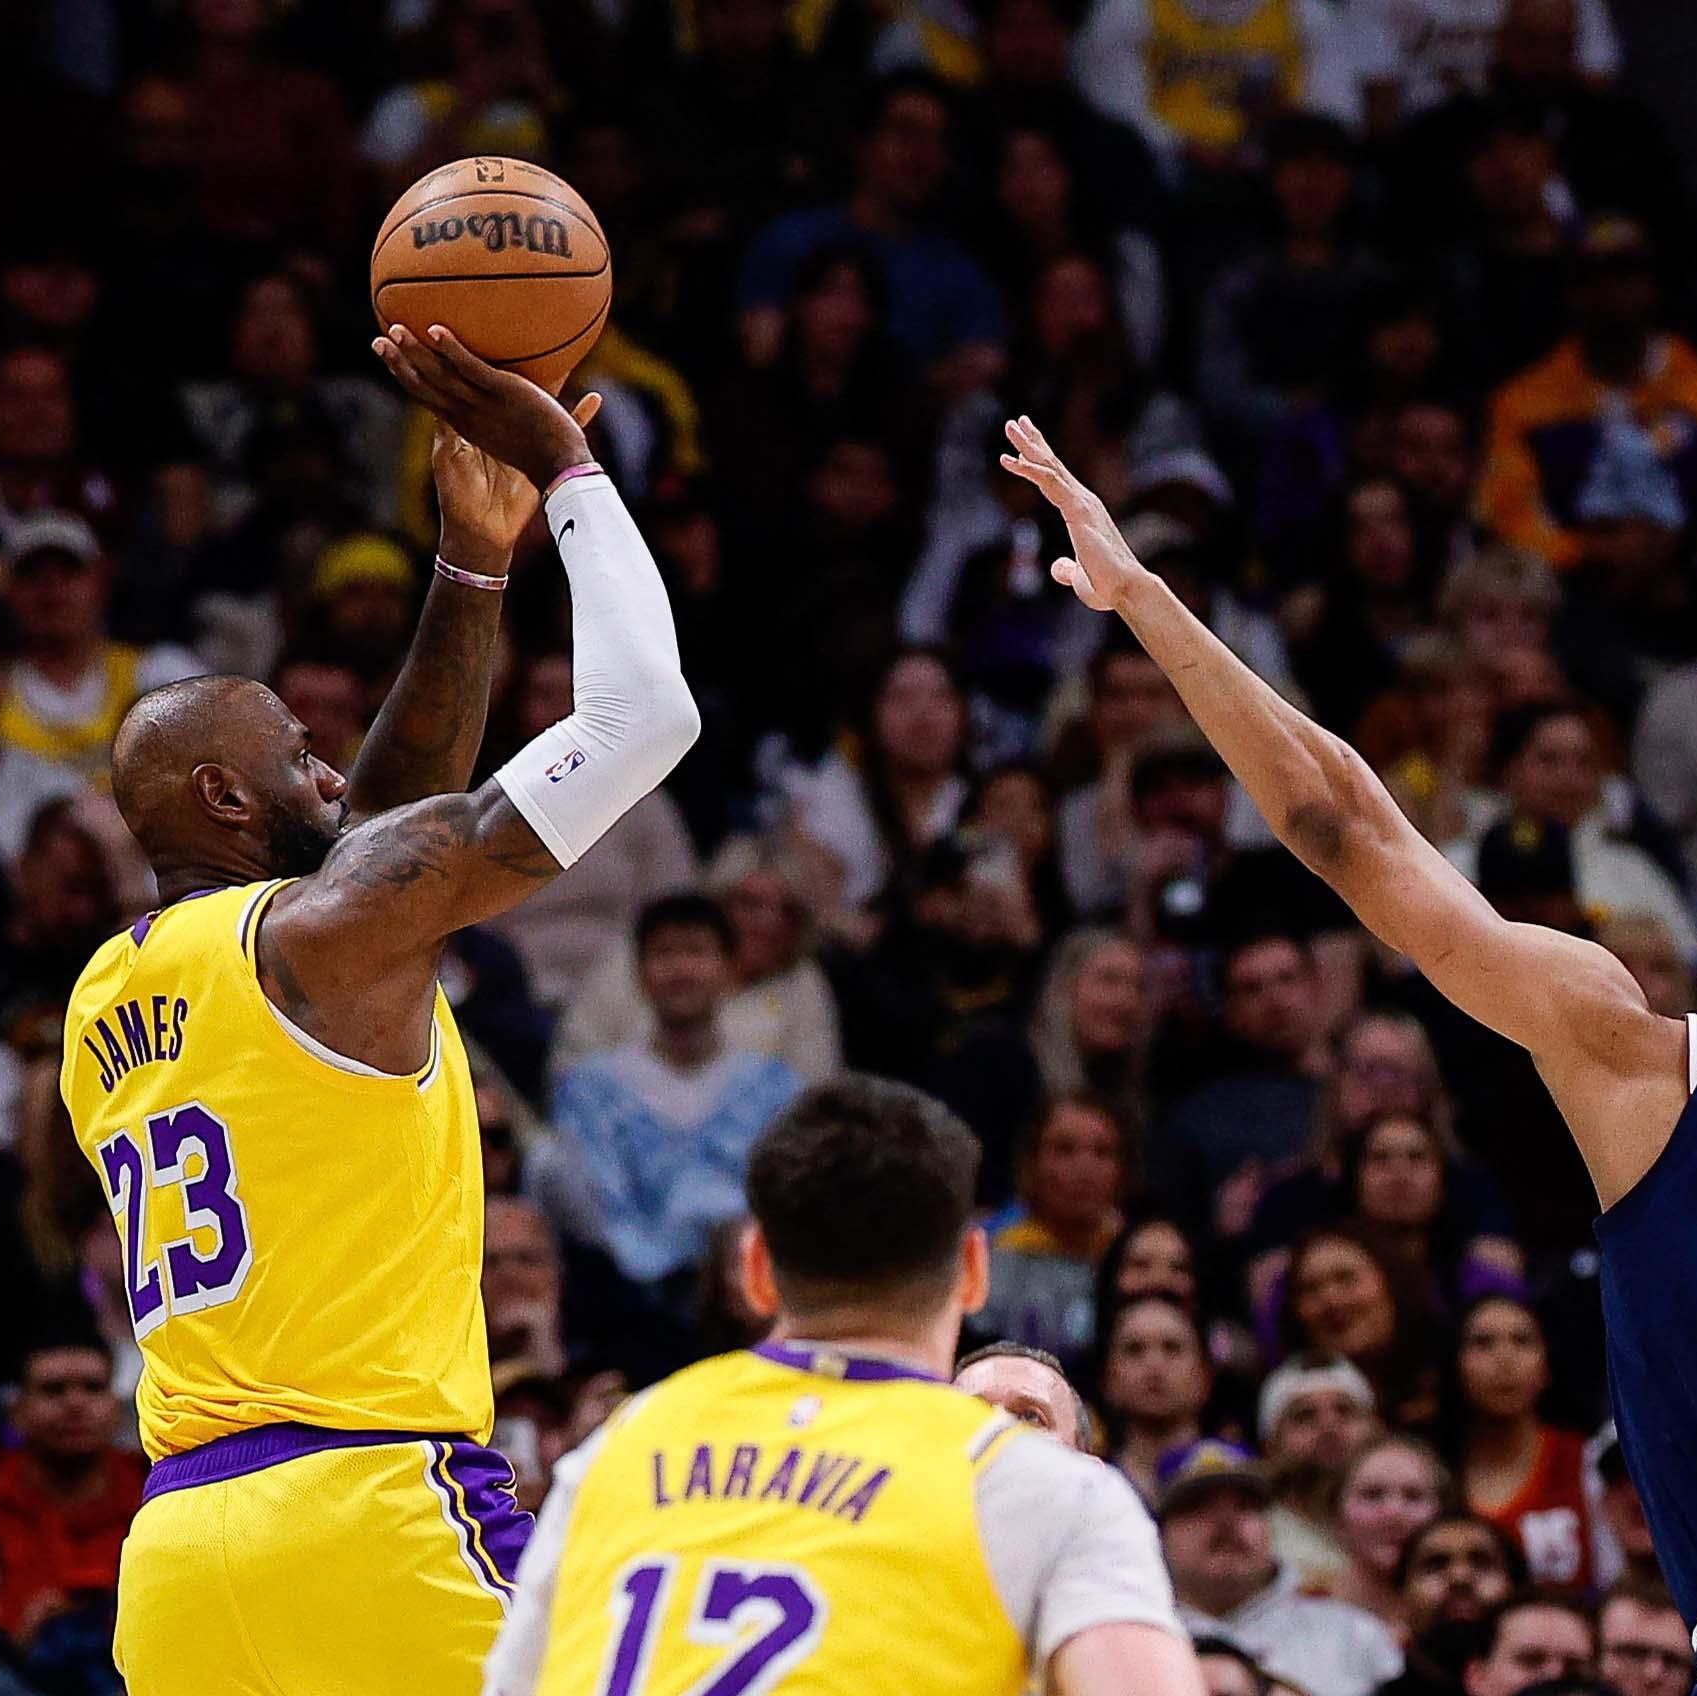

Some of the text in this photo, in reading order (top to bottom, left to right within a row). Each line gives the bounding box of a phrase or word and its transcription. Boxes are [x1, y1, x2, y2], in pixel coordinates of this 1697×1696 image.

[410, 210, 572, 259] Wilson
[83, 995, 189, 1093] JAMES
[95, 1098, 254, 1342] 23
[651, 1441, 894, 1526] LARAVIA
